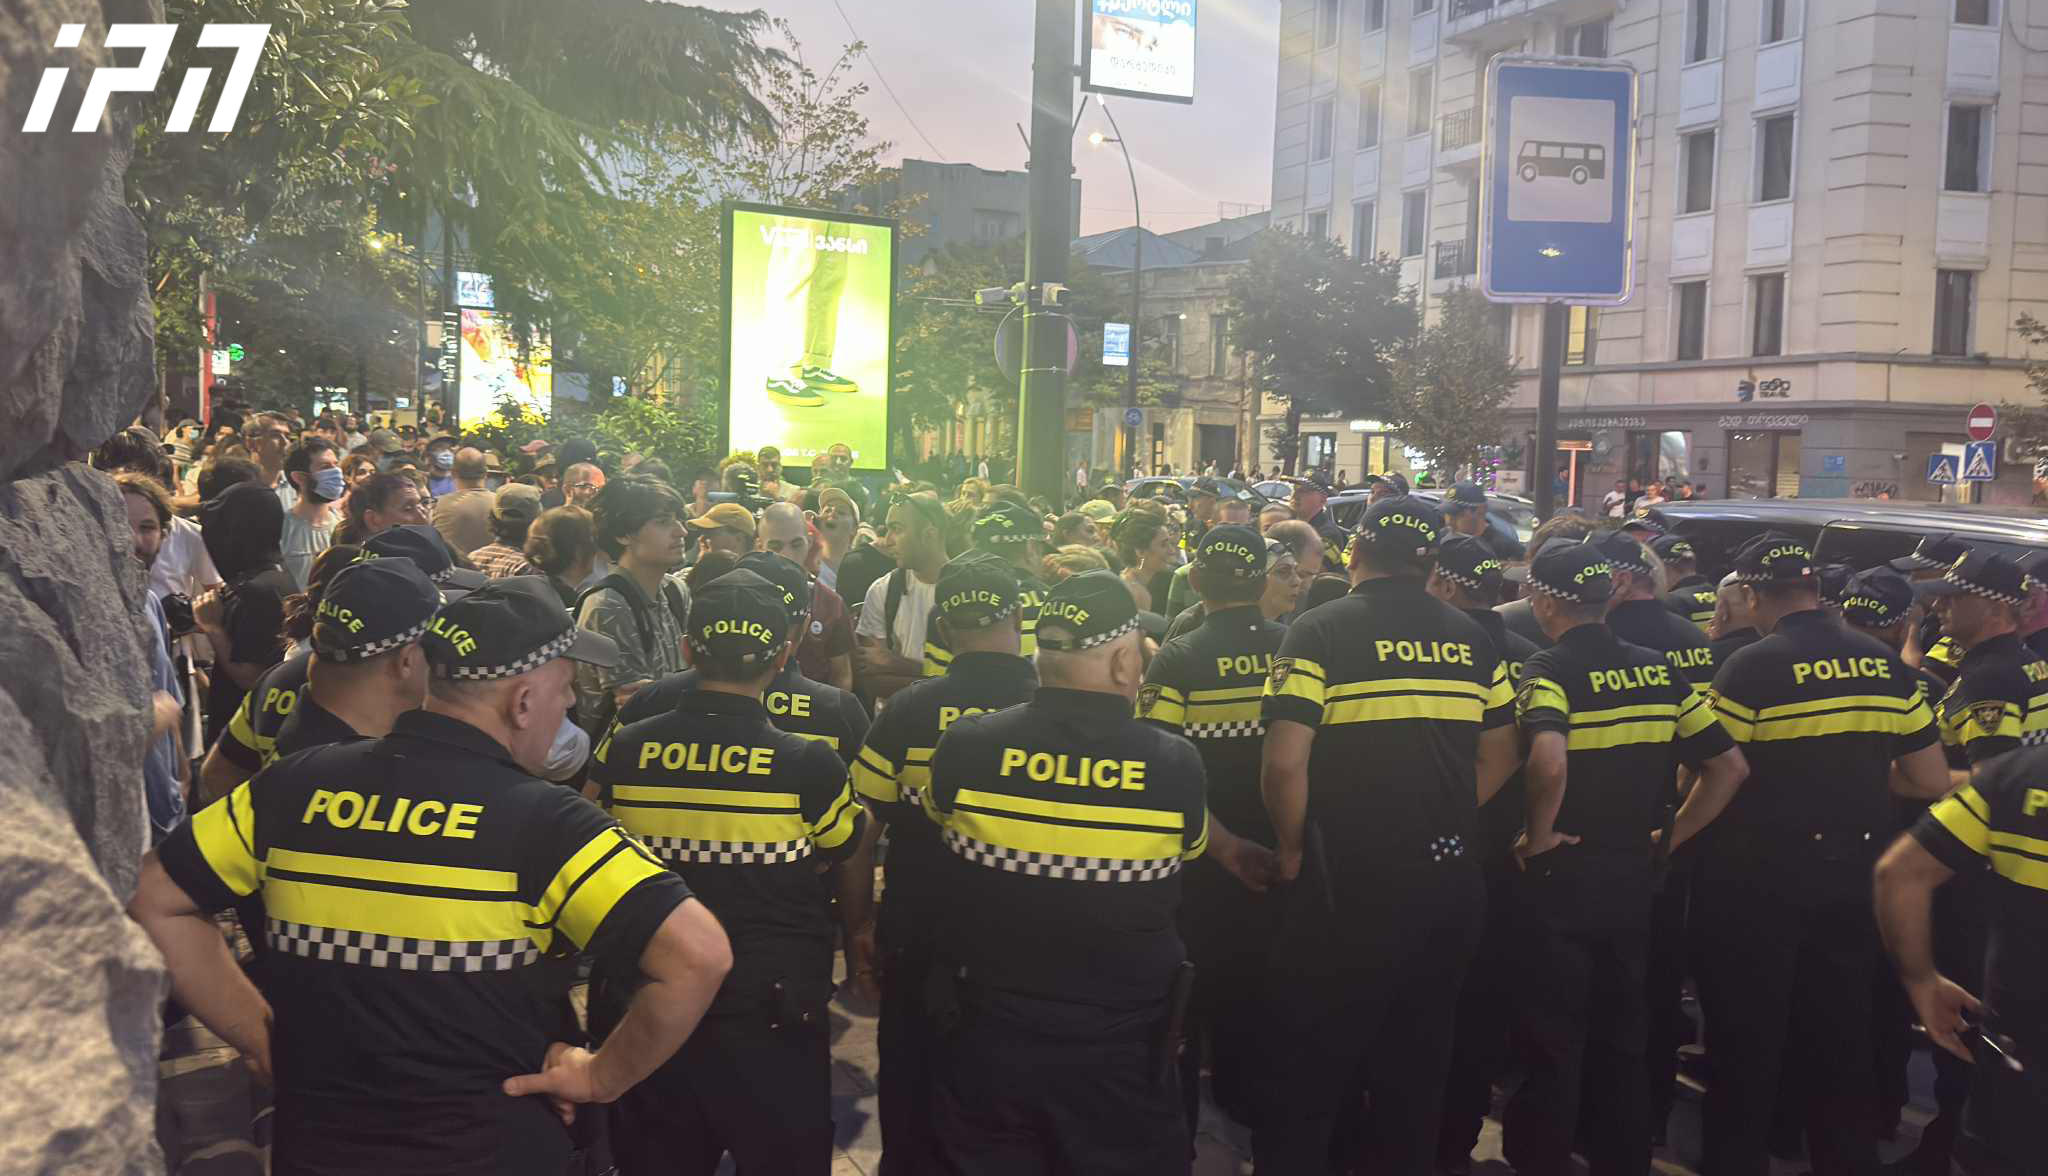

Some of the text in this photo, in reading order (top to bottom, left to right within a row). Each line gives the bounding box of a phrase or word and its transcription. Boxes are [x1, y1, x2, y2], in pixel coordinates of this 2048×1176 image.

[1379, 514, 1436, 541] POLICE
[1206, 542, 1256, 563] POLICE
[941, 590, 1002, 613] POLICE
[703, 620, 775, 645] POLICE
[1216, 653, 1273, 678] POLI
[1376, 640, 1473, 666] POLICE
[1666, 647, 1714, 668] OLICE
[1589, 665, 1672, 693] POLICE
[1793, 657, 1892, 684] POLICE
[638, 742, 775, 776] POLICE
[1000, 748, 1146, 791] POLICE
[302, 789, 484, 840] POLICE
